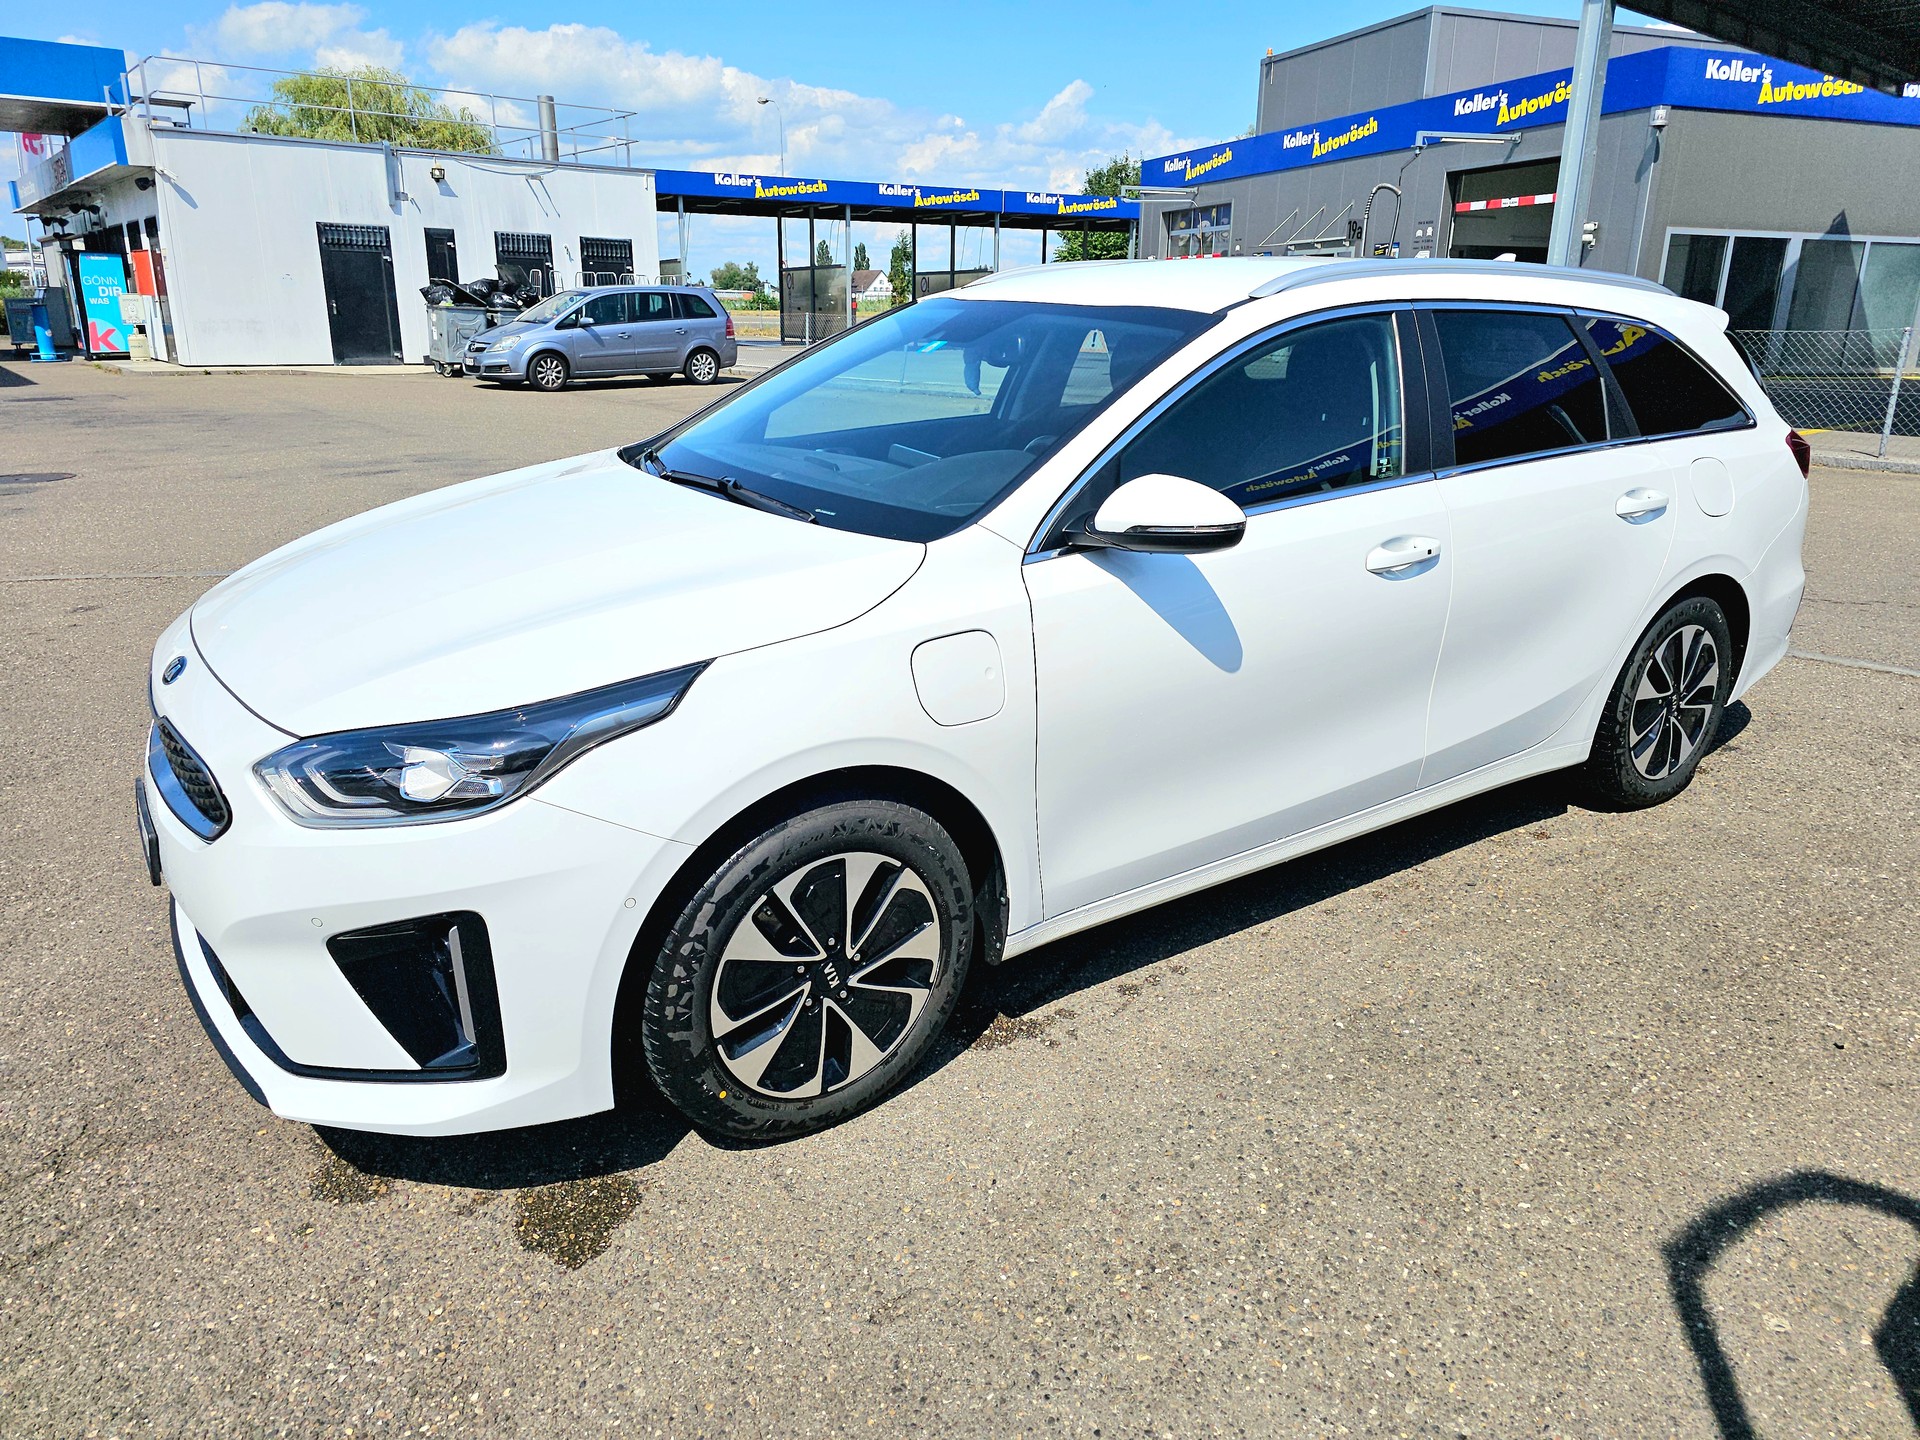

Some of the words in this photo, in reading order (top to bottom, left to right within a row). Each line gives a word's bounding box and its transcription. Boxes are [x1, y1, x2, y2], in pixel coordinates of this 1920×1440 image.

[1705, 59, 1773, 84] Koller's
[1454, 89, 1508, 116] Koller's
[1496, 81, 1573, 126] Autowös
[1283, 129, 1320, 149] Koller's
[1312, 117, 1378, 158] Autowösch
[1164, 156, 1191, 173] Koller's
[1185, 147, 1232, 181] Autowösch
[714, 173, 762, 187] Koller's
[755, 179, 828, 198] Autowösch
[878, 184, 921, 197] Koller's
[914, 189, 980, 207] Autowösch
[1026, 193, 1064, 205] Koller's
[1058, 196, 1117, 214] Autowösch
[82, 275, 118, 286] GÖNN
[98, 286, 122, 297] DIR
[823, 962, 840, 989] KIA
